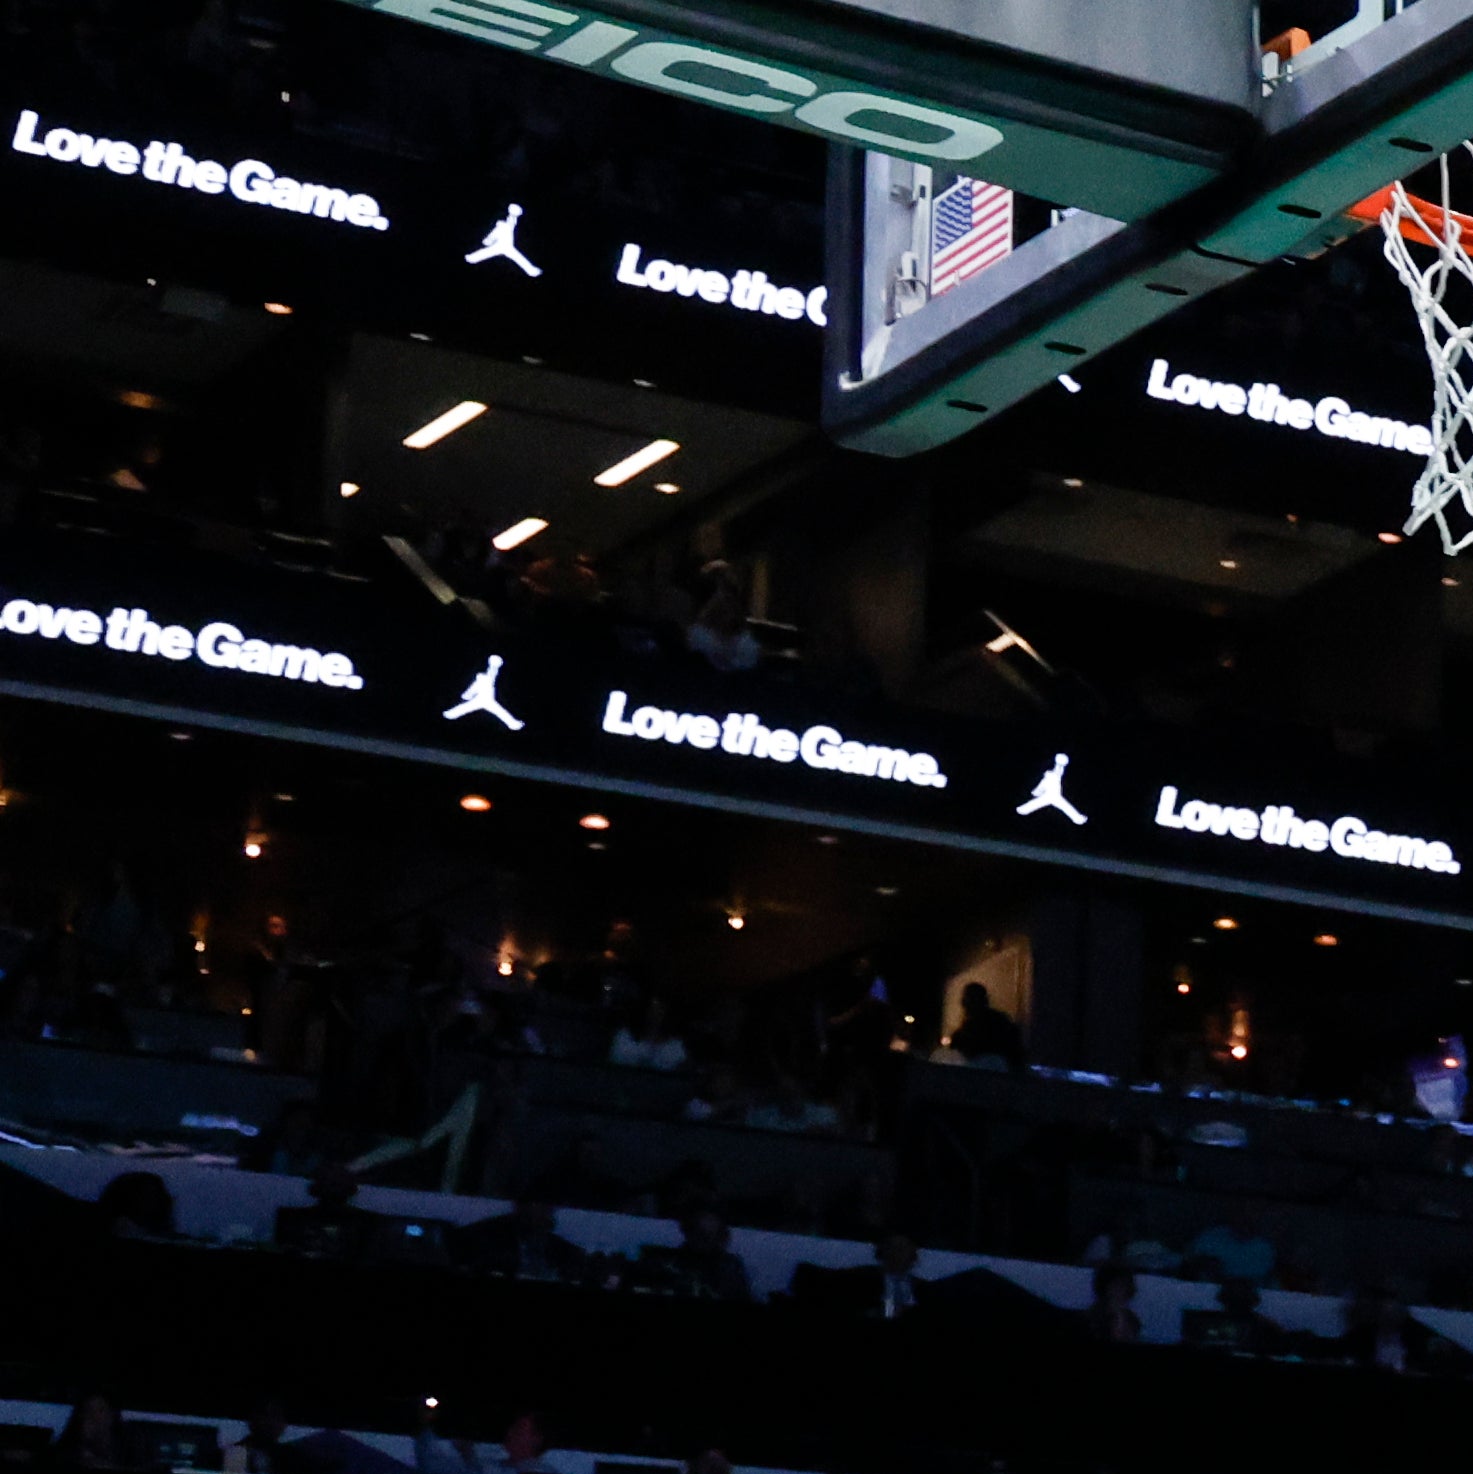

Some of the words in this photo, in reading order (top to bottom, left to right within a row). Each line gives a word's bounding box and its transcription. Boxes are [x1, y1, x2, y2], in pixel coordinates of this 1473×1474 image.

[368, 0, 1004, 160] EICO
[12, 109, 141, 174] Love
[142, 140, 228, 193] the
[229, 158, 389, 230] Game.
[618, 243, 731, 303] Love
[731, 269, 805, 319] the
[1146, 358, 1247, 415] Love
[1247, 381, 1315, 430] the
[0, 598, 103, 646] ove
[104, 606, 195, 661] the
[196, 622, 364, 690] Game.
[603, 690, 720, 750] Love
[721, 712, 801, 763] the
[801, 725, 949, 788] Game.
[1155, 785, 1260, 840] Love
[1260, 804, 1330, 852] the
[1330, 815, 1461, 875] Game.
